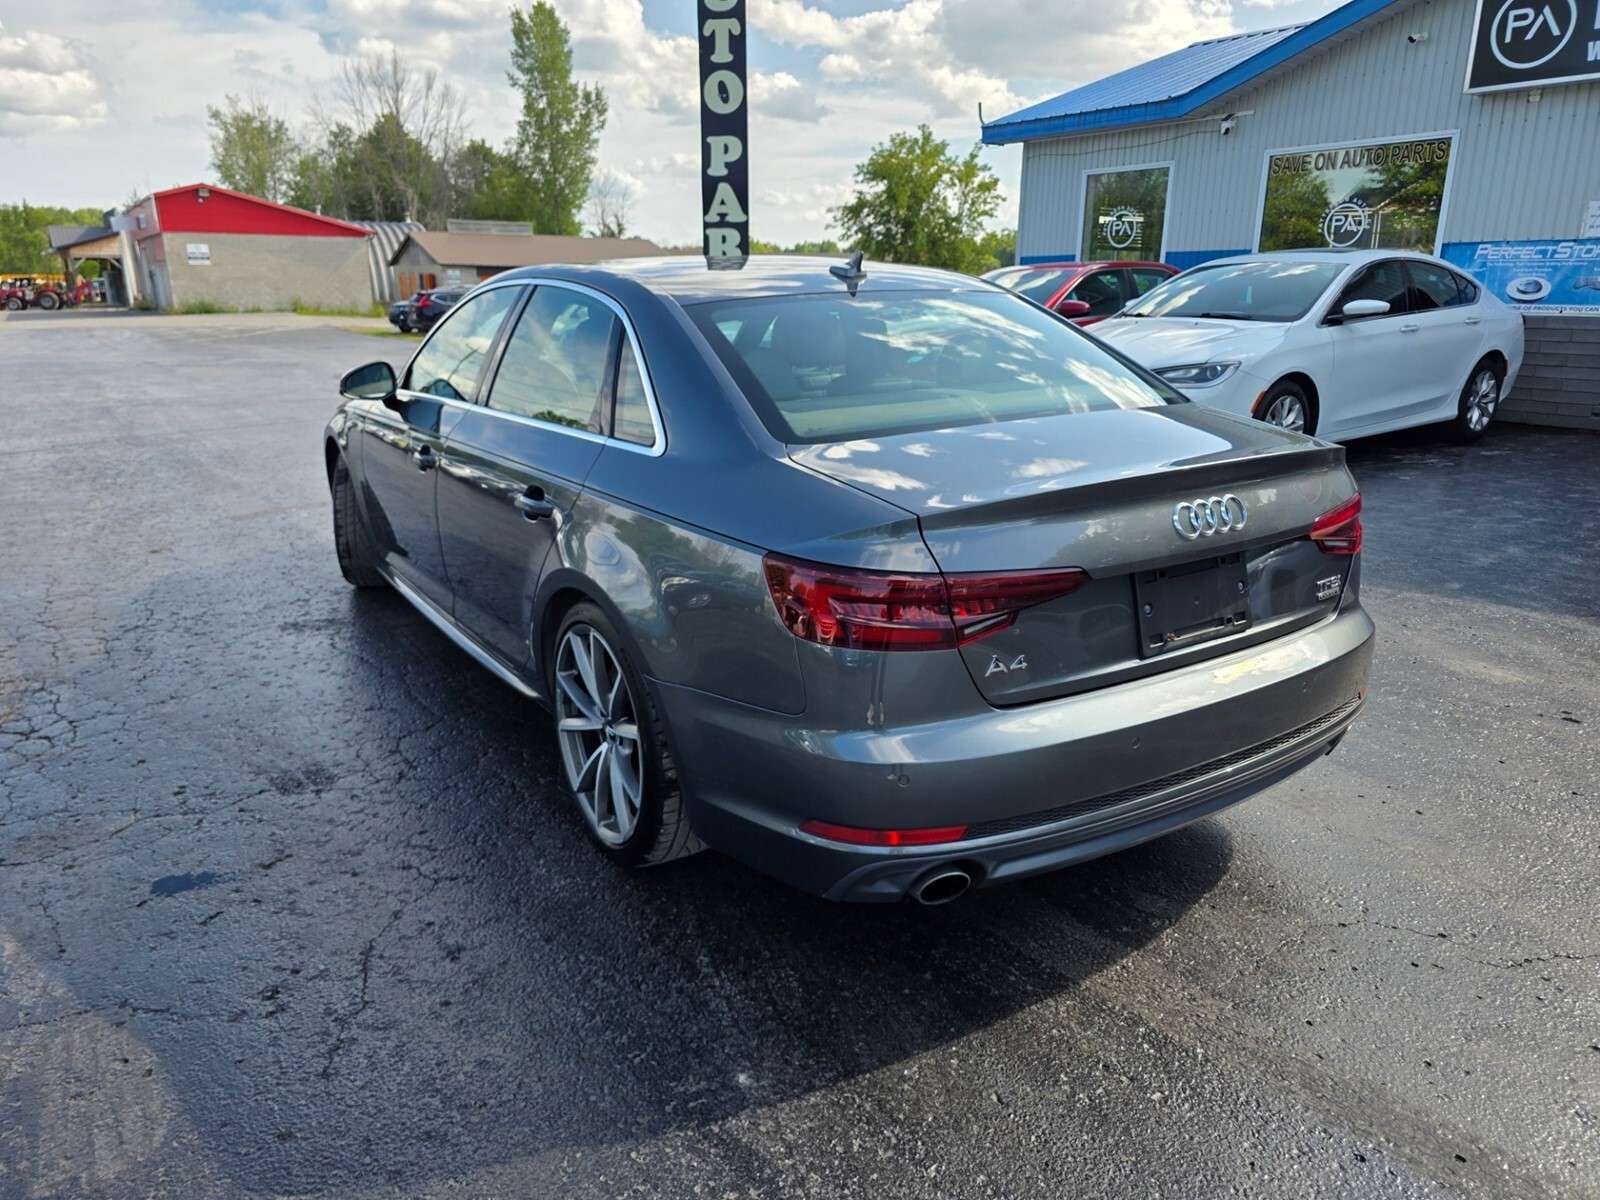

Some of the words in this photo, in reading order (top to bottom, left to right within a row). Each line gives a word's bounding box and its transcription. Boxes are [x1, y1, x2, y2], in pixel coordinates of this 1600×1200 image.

[1504, 5, 1561, 43] PA
[703, 0, 744, 115] TO
[1271, 154, 1312, 176] SAVE
[1314, 151, 1338, 171] ON
[1340, 147, 1386, 169] AUTO
[1390, 140, 1449, 164] PARTS
[984, 654, 1028, 678] A4
